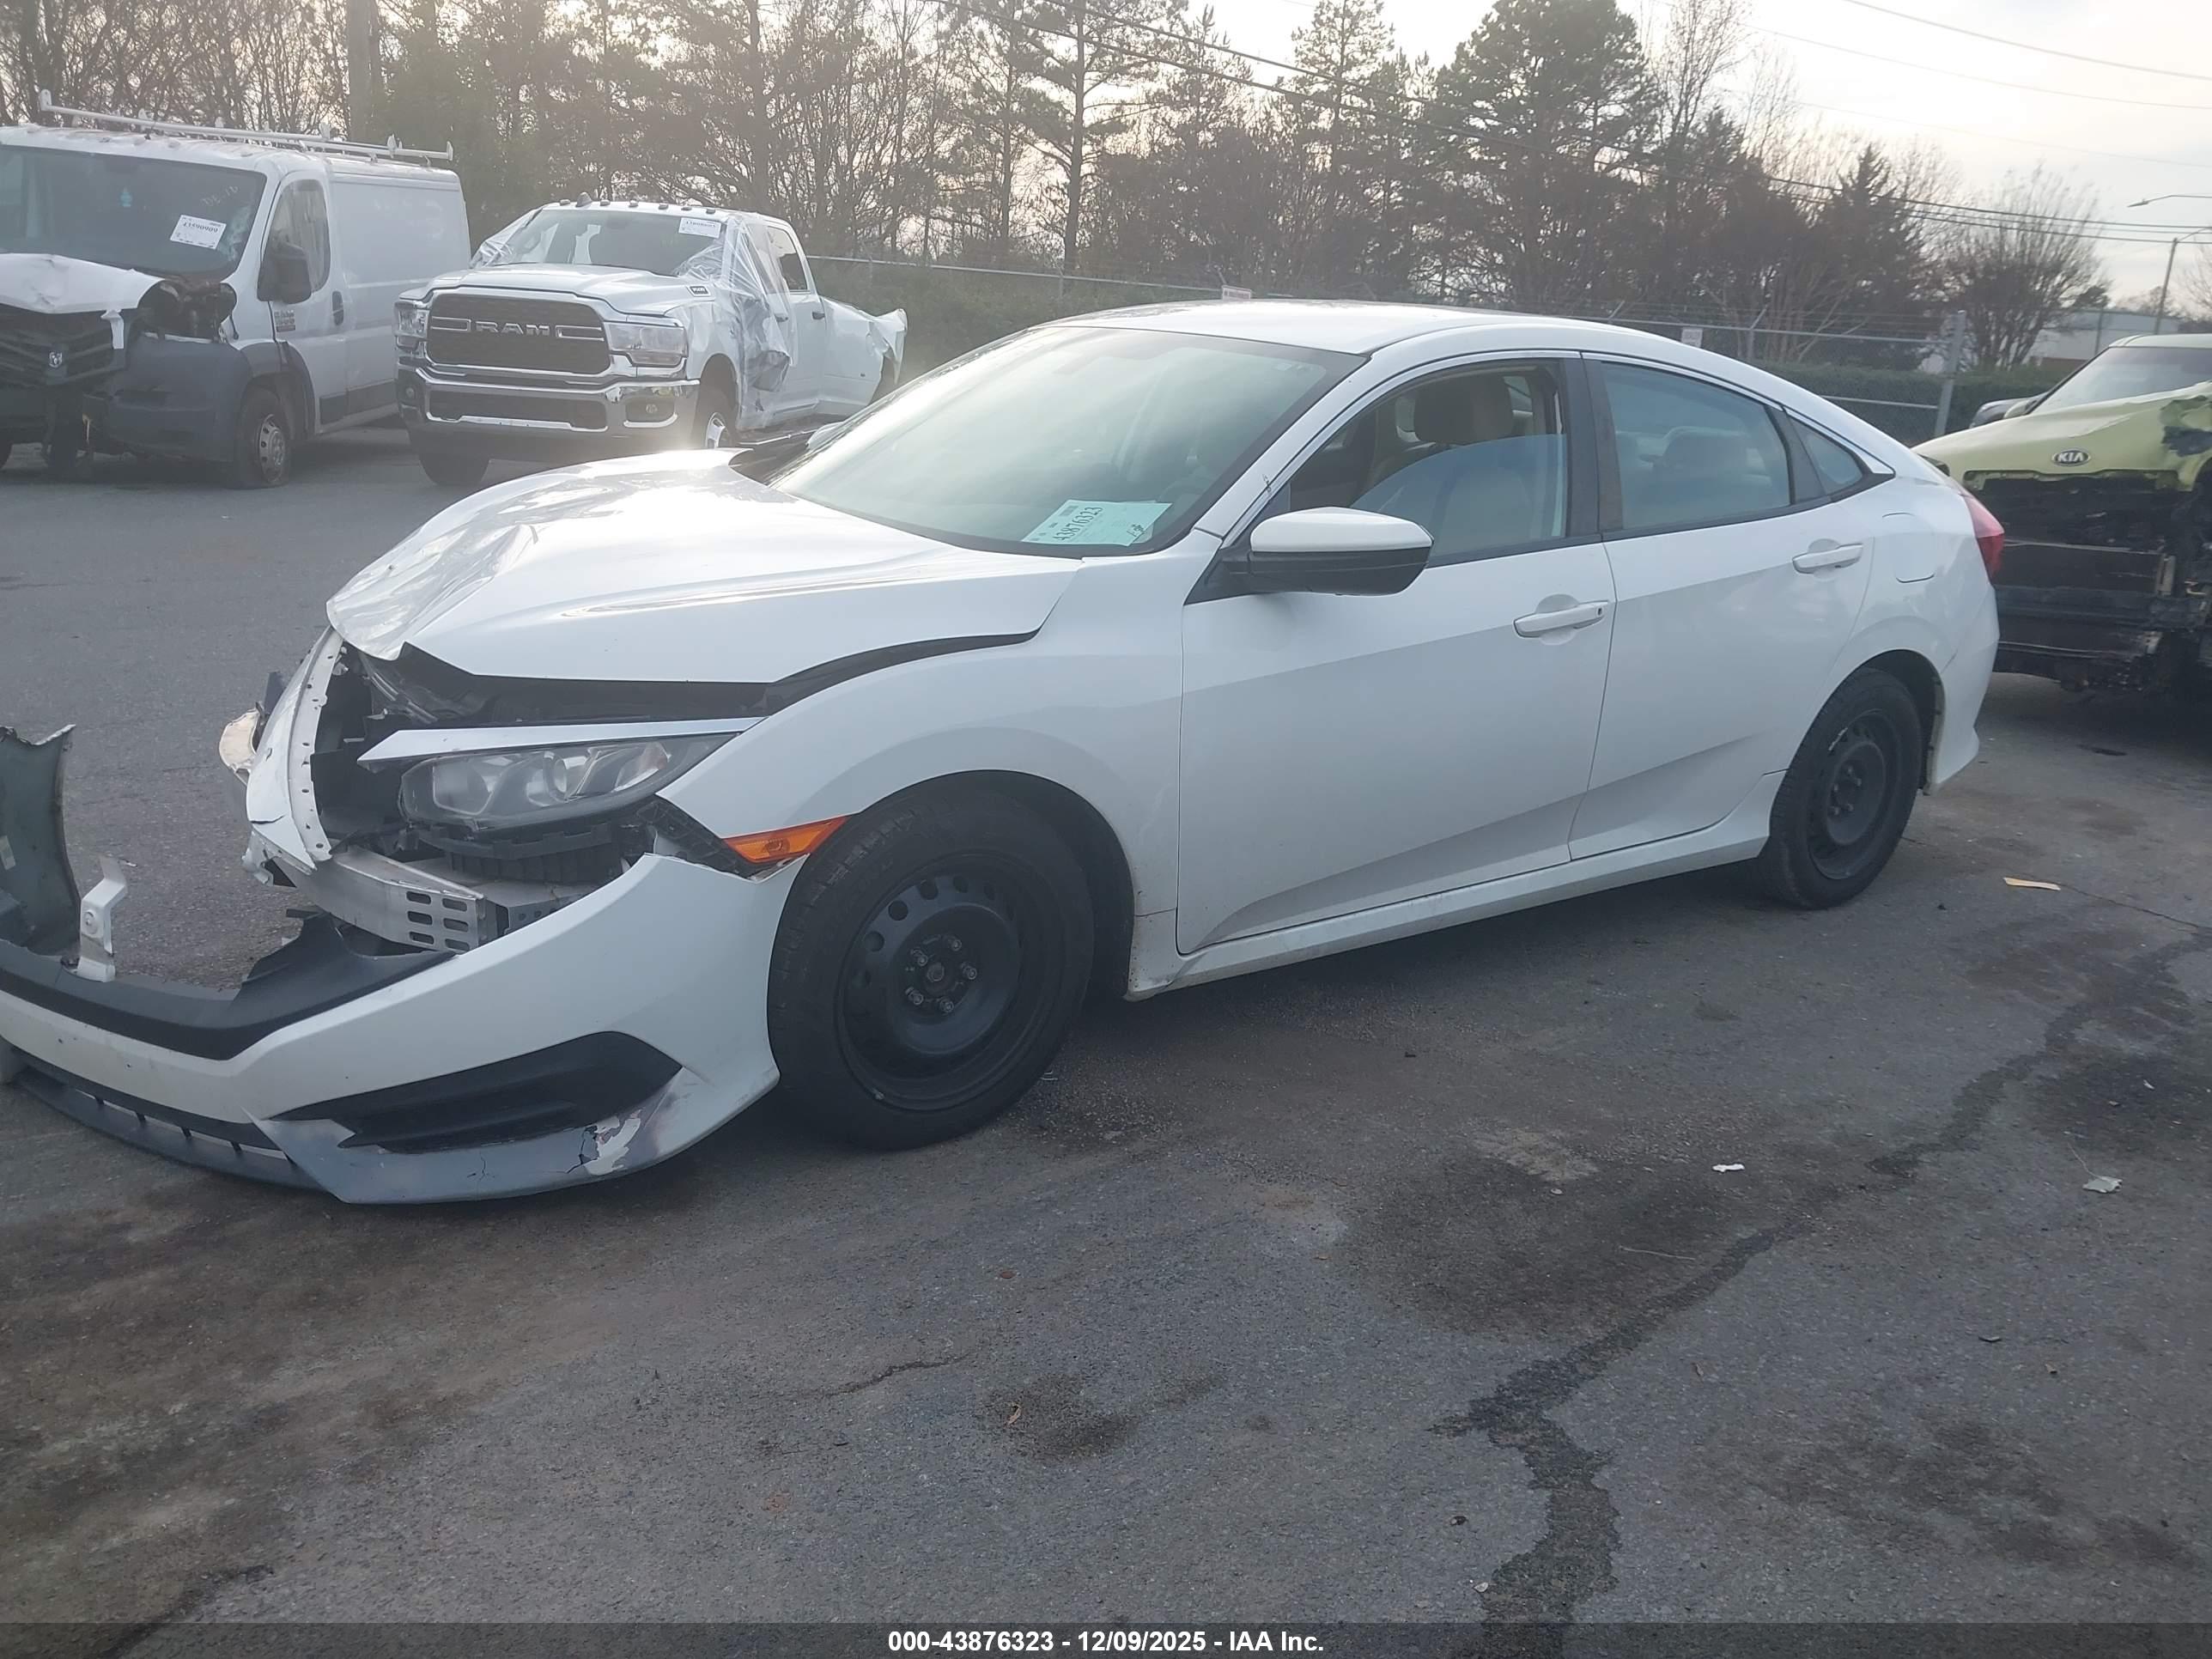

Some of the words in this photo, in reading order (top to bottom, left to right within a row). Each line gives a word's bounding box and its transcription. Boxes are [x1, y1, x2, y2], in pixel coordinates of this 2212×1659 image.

[475, 321, 550, 336] RAM
[2057, 452, 2084, 462] KIA
[1053, 506, 1103, 541] 43876323
